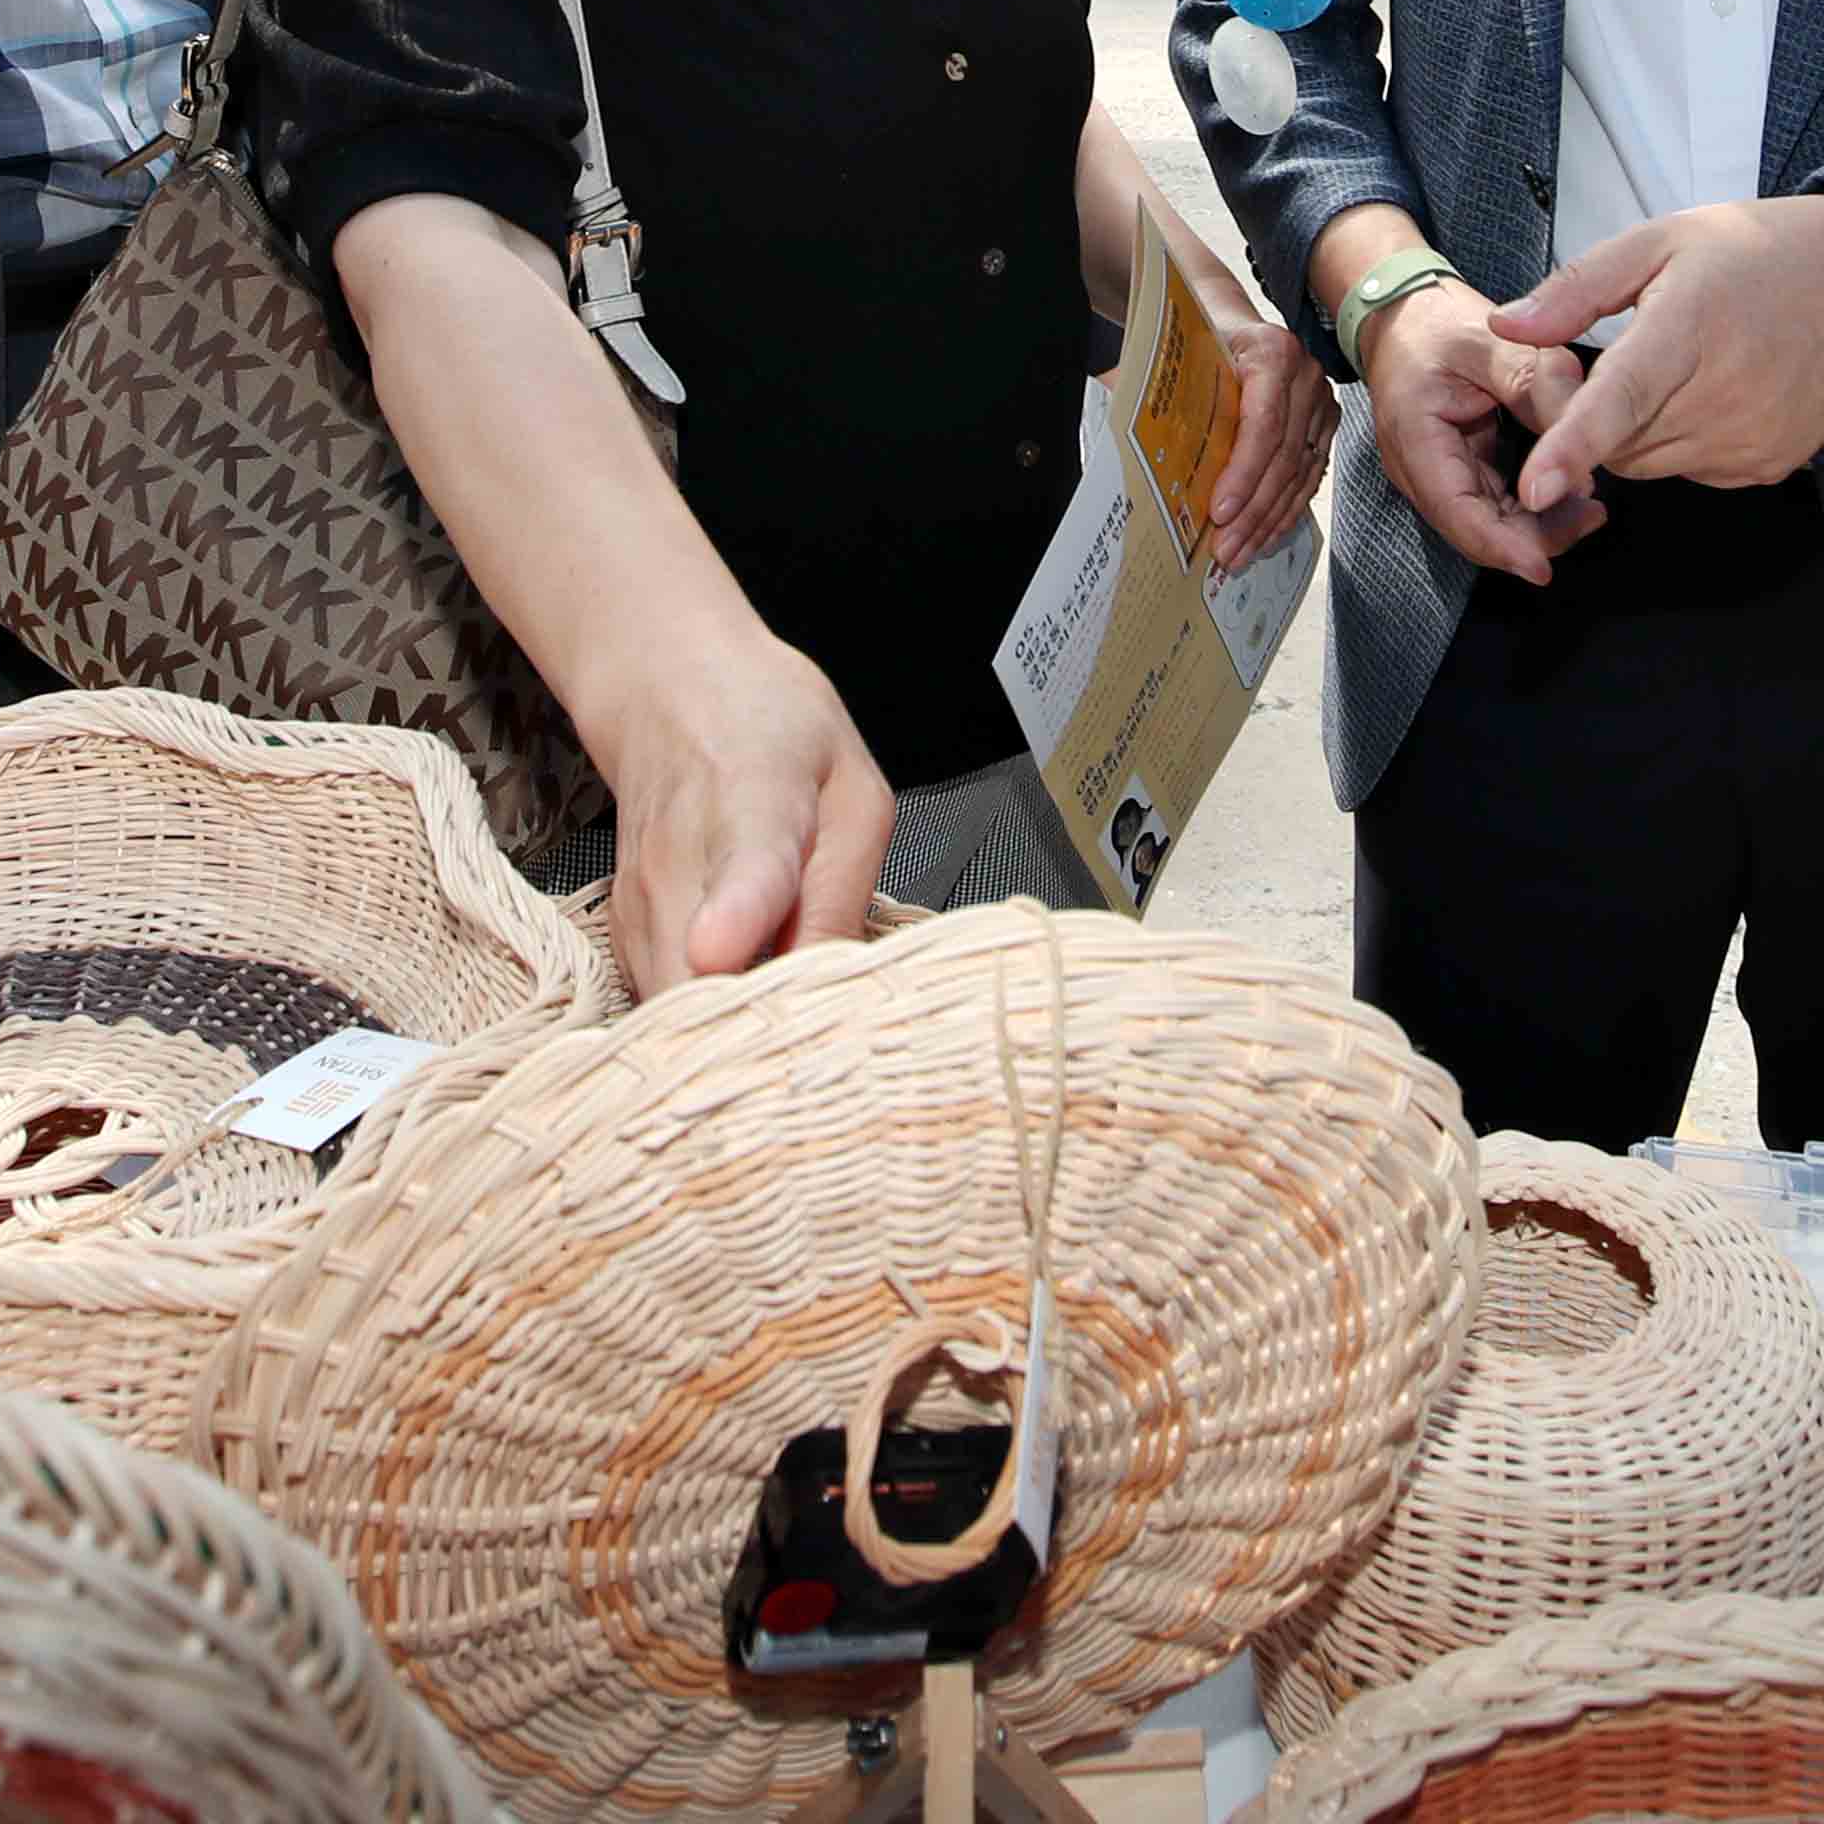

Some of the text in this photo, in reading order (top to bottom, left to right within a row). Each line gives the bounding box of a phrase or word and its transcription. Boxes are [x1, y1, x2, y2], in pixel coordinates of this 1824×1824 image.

[77, 325, 177, 435] MK
[150, 301, 272, 412] MK
[75, 416, 176, 526] MK
[154, 394, 272, 499] MK
[160, 479, 268, 584] MK
[247, 464, 362, 560] MK
[22, 540, 103, 649] MK
[83, 512, 183, 621] MK
[242, 543, 362, 648] MK
[176, 574, 268, 682] MK
